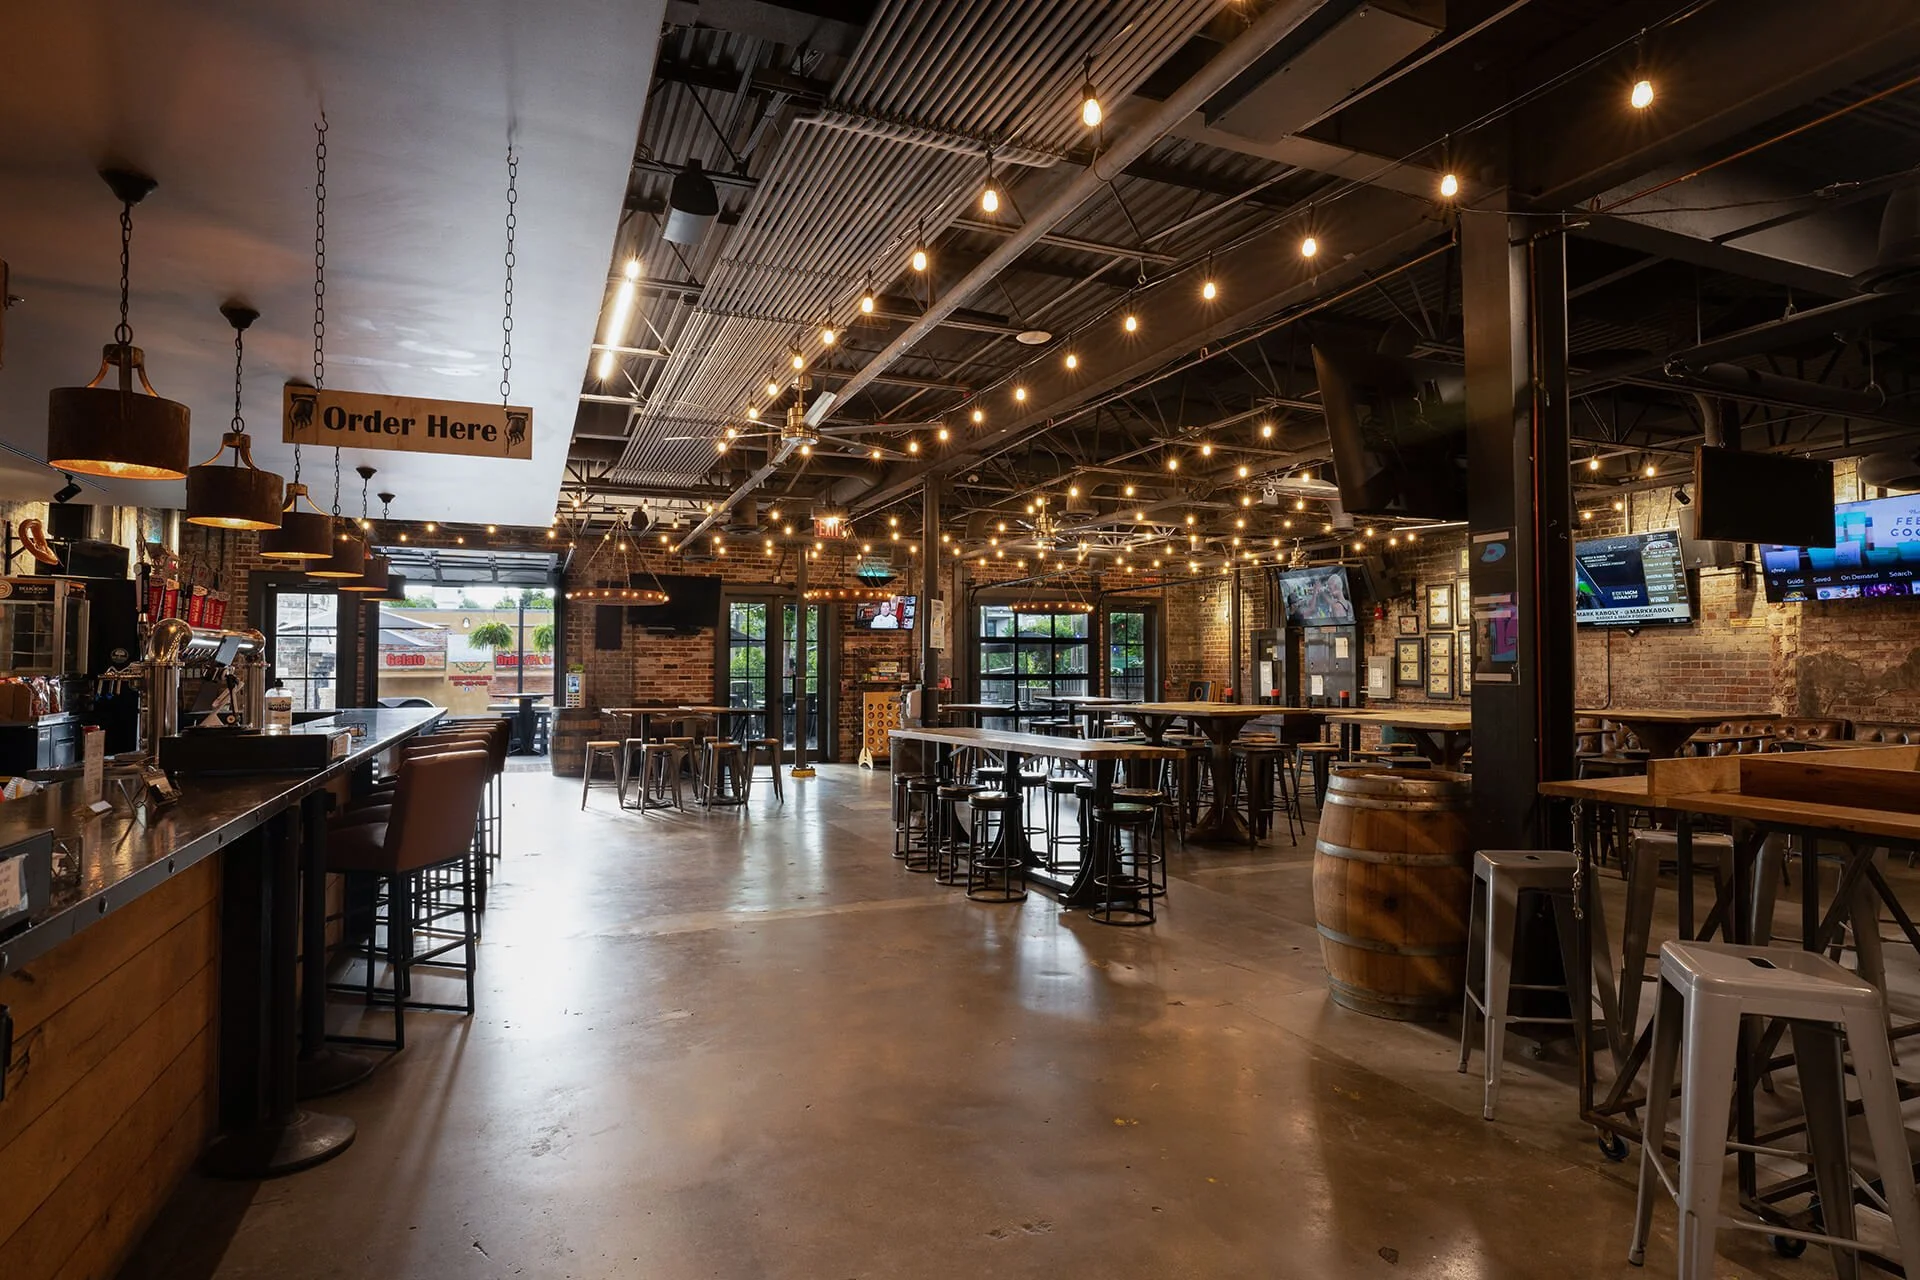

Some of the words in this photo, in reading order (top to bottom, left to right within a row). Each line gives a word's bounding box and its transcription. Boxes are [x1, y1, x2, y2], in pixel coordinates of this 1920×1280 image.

[323, 406, 416, 436] Order
[427, 414, 497, 442] Here
[819, 519, 838, 537] EXIT
[1852, 572, 1879, 580] Demand
[1888, 570, 1913, 578] Search
[1812, 576, 1832, 584] Saved
[386, 653, 426, 666] Gelato
